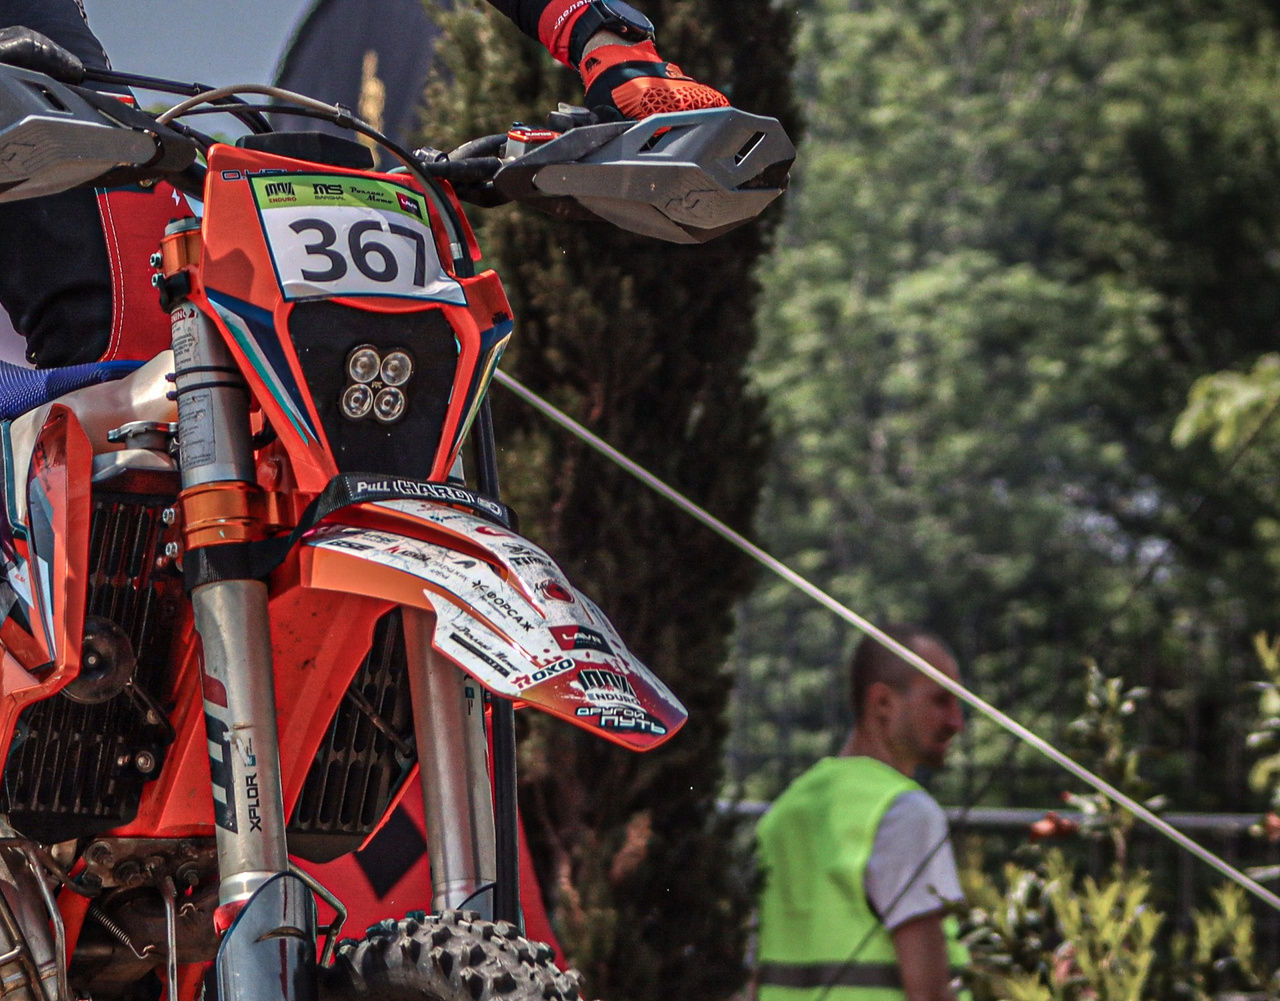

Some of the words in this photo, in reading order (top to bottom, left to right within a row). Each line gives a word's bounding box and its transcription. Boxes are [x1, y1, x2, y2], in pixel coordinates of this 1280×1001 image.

[289, 218, 425, 288] 367
[487, 591, 535, 632] ФОРСАЖ
[561, 632, 602, 645] LAVR
[576, 706, 646, 720] ДРУГОЙ
[600, 715, 667, 735] ПУТЬ
[246, 773, 262, 832] XPLOR
